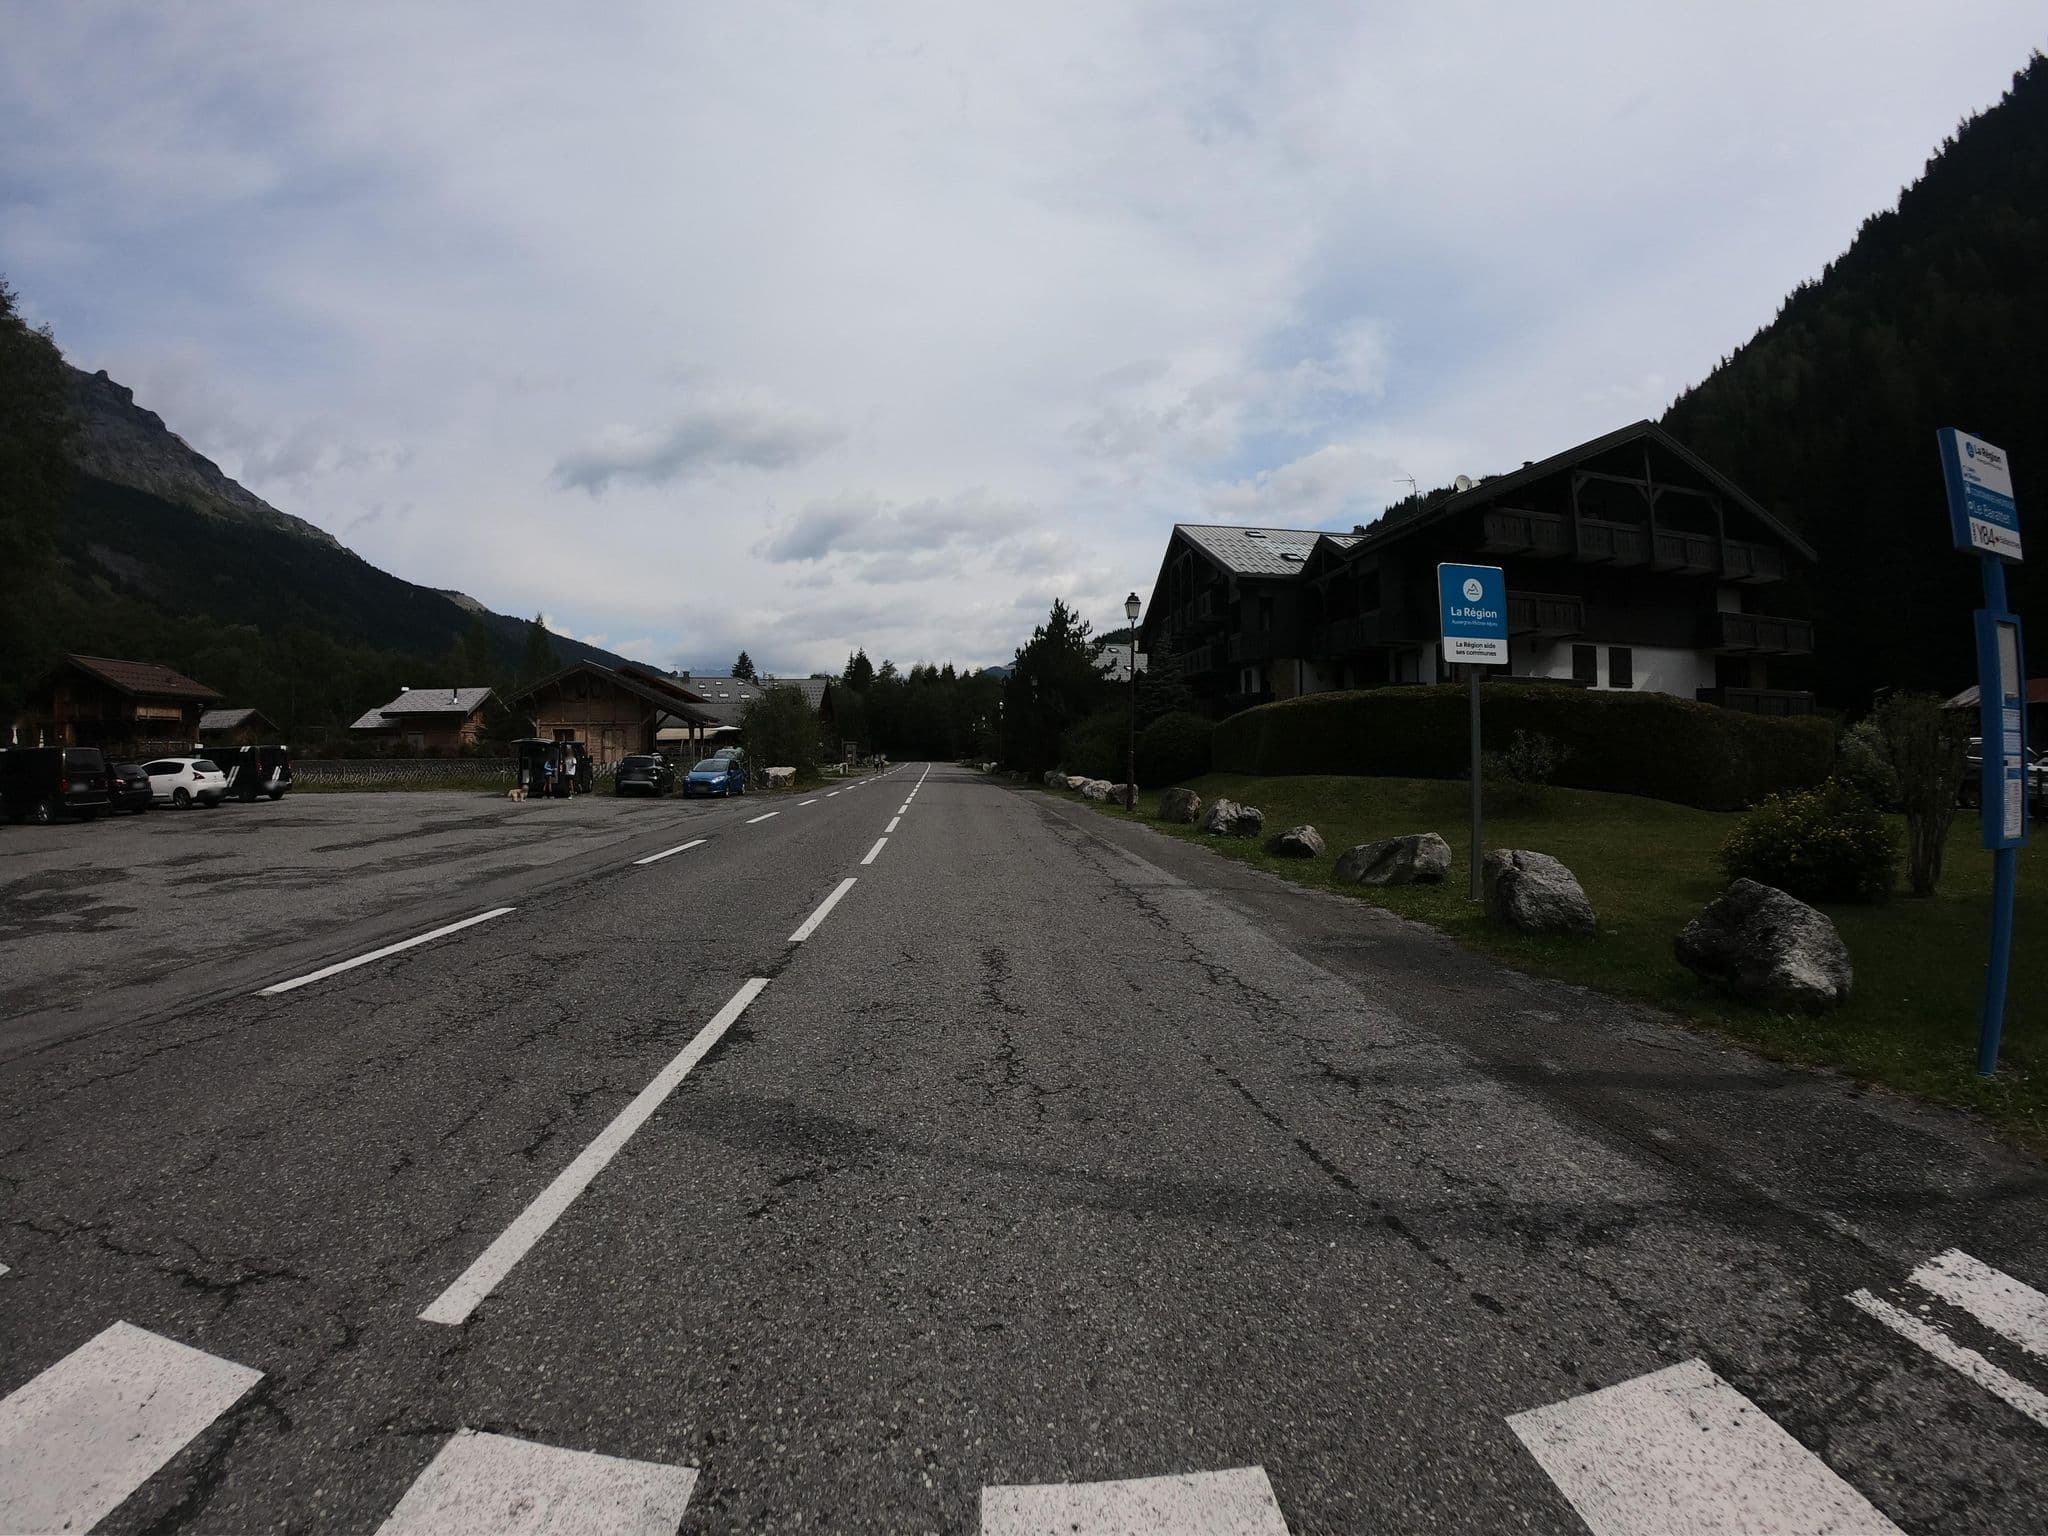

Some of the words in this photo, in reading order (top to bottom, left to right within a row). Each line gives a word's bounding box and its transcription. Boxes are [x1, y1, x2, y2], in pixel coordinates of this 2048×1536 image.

[1451, 606, 1462, 616] La
[1464, 607, 1497, 619] Région
[1463, 641, 1483, 649] Région
